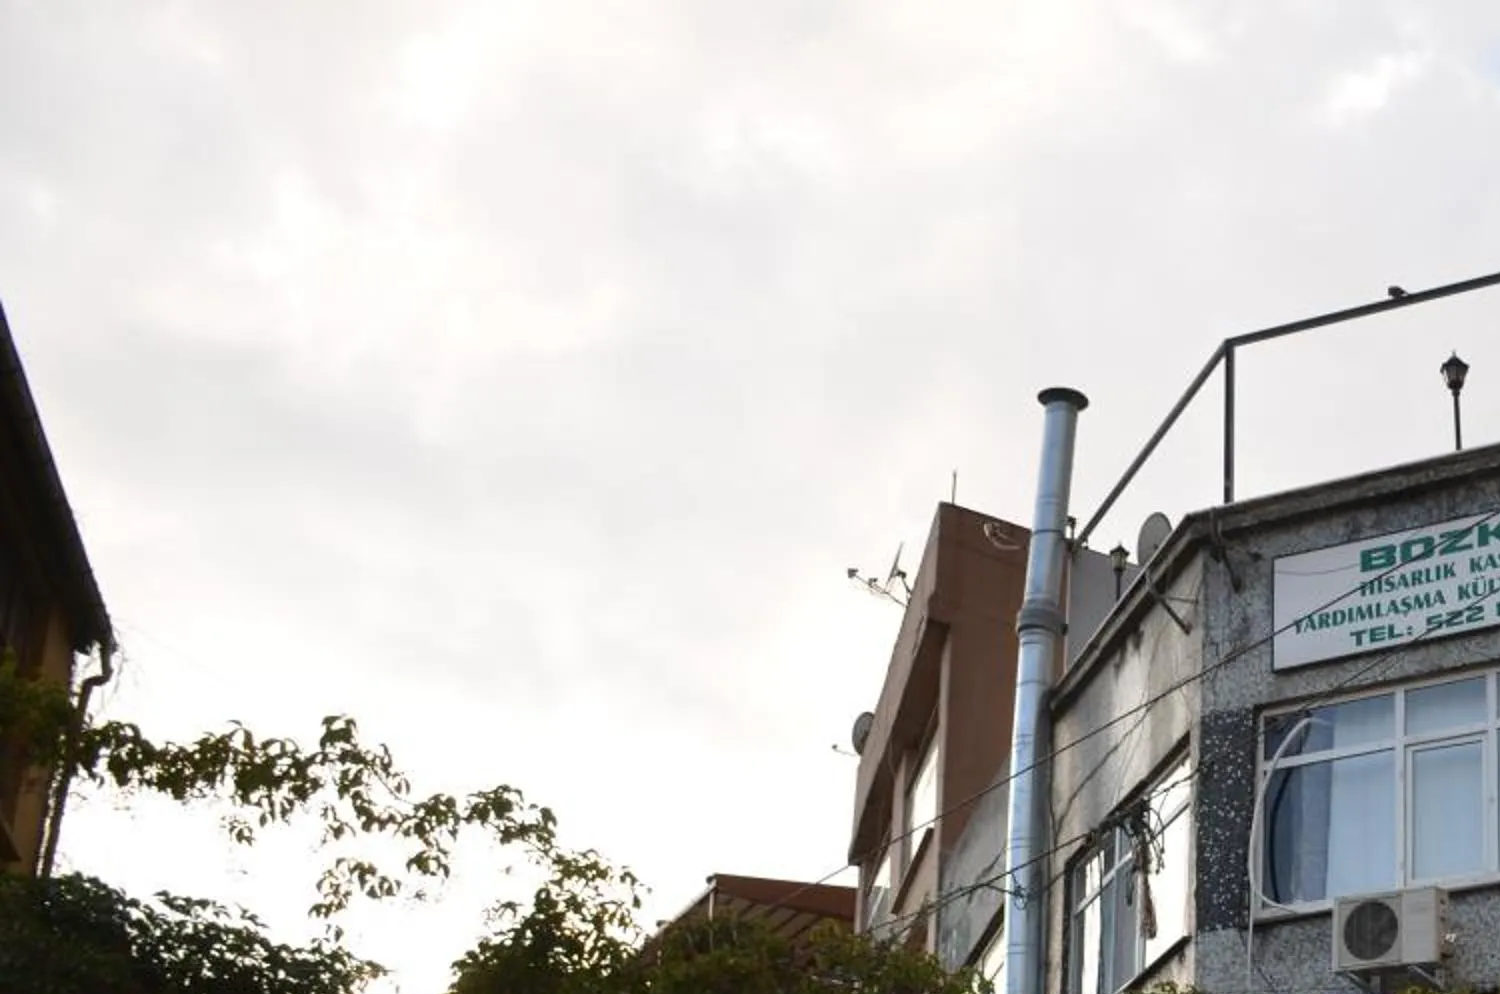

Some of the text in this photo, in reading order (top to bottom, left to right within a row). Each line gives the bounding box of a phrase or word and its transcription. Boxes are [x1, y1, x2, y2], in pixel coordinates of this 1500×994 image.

[1360, 561, 1456, 597] HISARLIK
[1349, 623, 1414, 647] TEL:
[1426, 604, 1485, 634] 522
